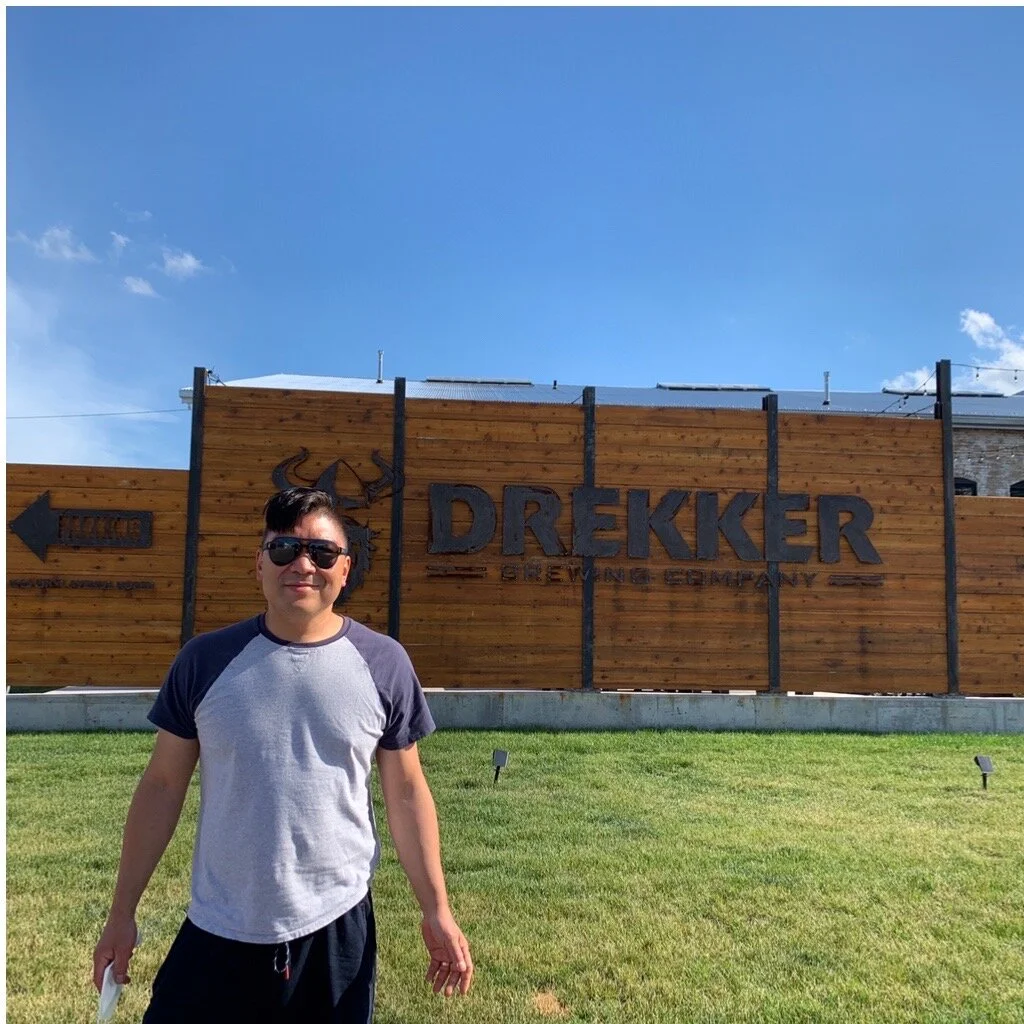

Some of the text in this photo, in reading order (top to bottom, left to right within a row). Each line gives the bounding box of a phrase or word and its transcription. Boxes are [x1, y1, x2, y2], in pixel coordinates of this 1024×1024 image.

[427, 482, 884, 565] DREKKER
[500, 559, 819, 589] BREWING COMPANY
